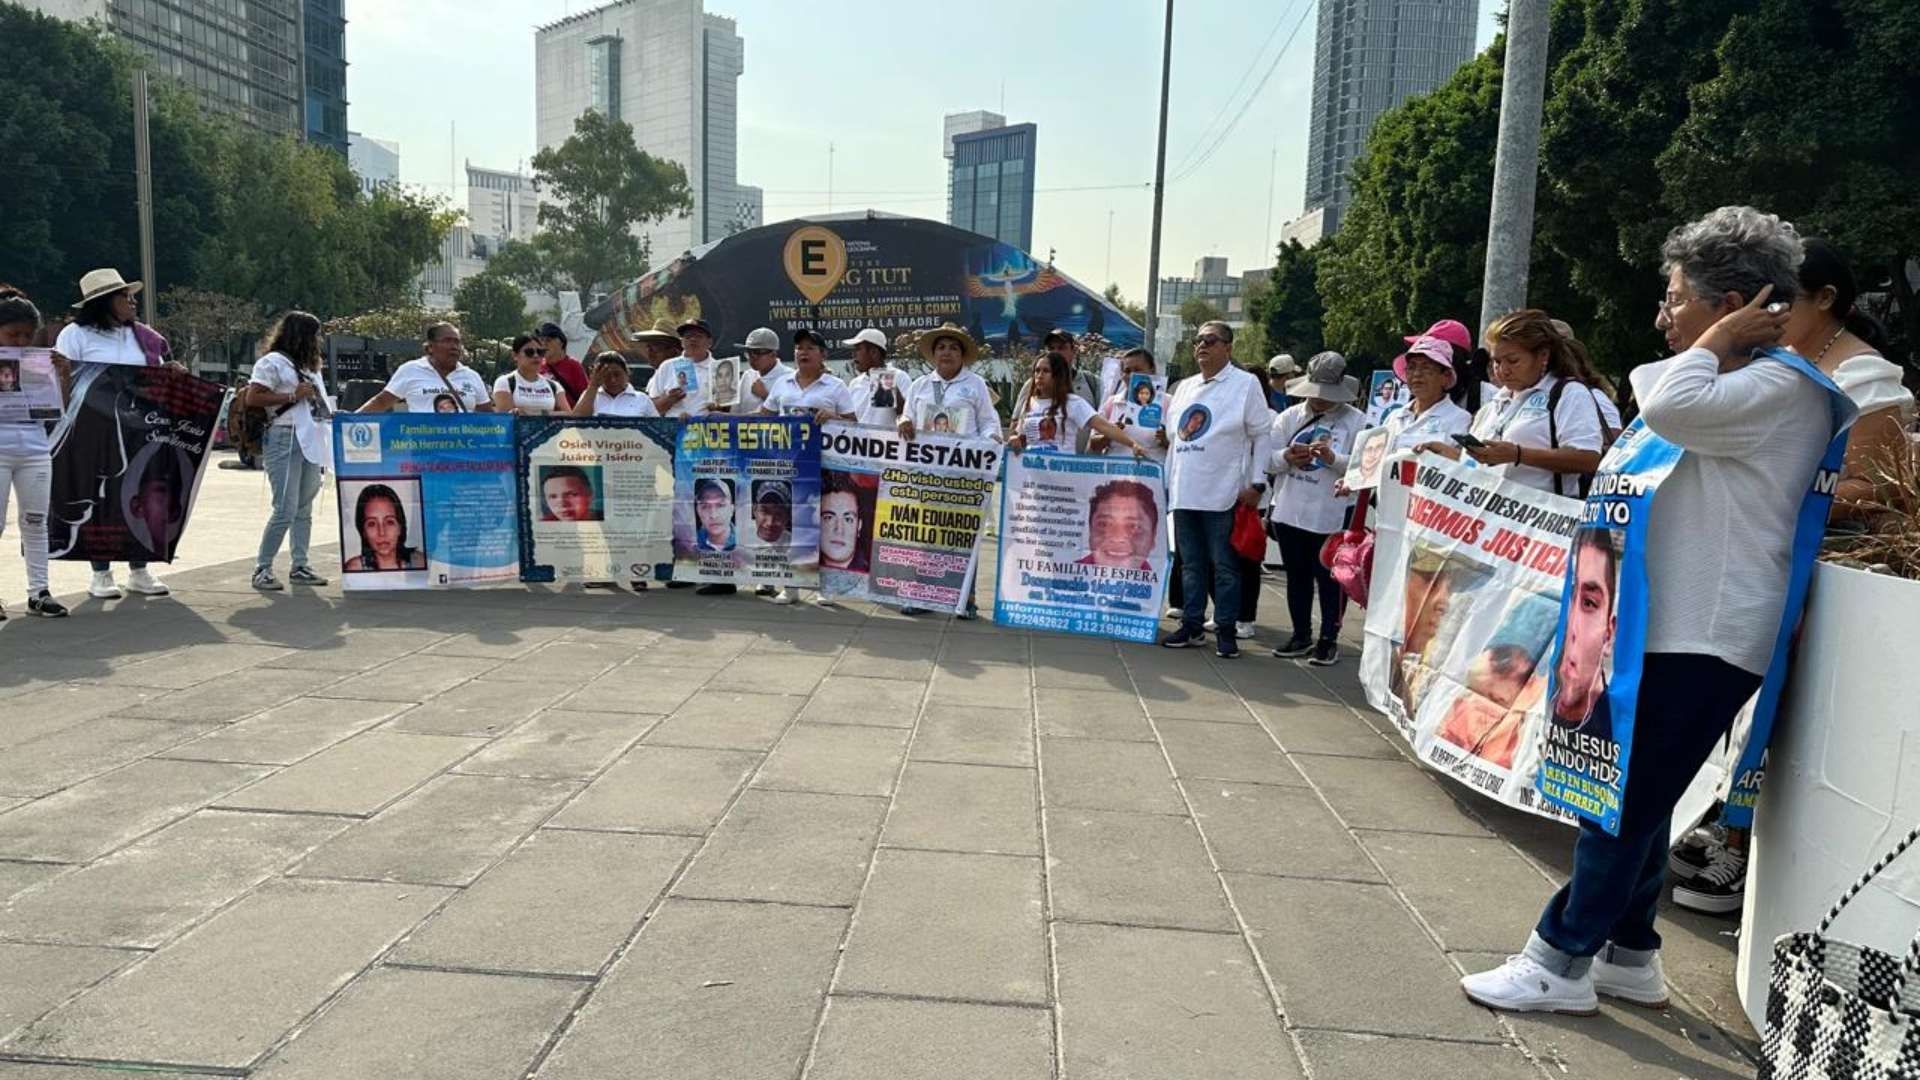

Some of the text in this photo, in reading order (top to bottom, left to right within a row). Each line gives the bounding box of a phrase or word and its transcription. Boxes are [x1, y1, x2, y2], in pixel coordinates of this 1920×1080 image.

[801, 240, 827, 275] E
[866, 267, 912, 285] TUT
[867, 304, 904, 316] EGIPTO
[908, 302, 922, 314] EN
[867, 319, 875, 328] A
[880, 318, 894, 328] LA
[898, 316, 940, 327] MADRE
[559, 440, 643, 451] Osiel Virgilio
[821, 430, 997, 470] DÓNDE ESTÁN?
[559, 452, 643, 462] Juárez Isidro
[882, 469, 909, 483] ¿Ha
[911, 472, 941, 486] visto
[944, 475, 982, 490] usted
[890, 486, 984, 506] esta persona?
[1442, 478, 1468, 500] DE
[1464, 487, 1488, 508] SU
[891, 503, 980, 531] IVÁN EDUARDO
[1604, 501, 1630, 525] YO
[880, 523, 936, 544] CASTILLO
[1017, 559, 1158, 583] TU FAMILIA TE ESPERA
[1571, 732, 1621, 763] JESUS
